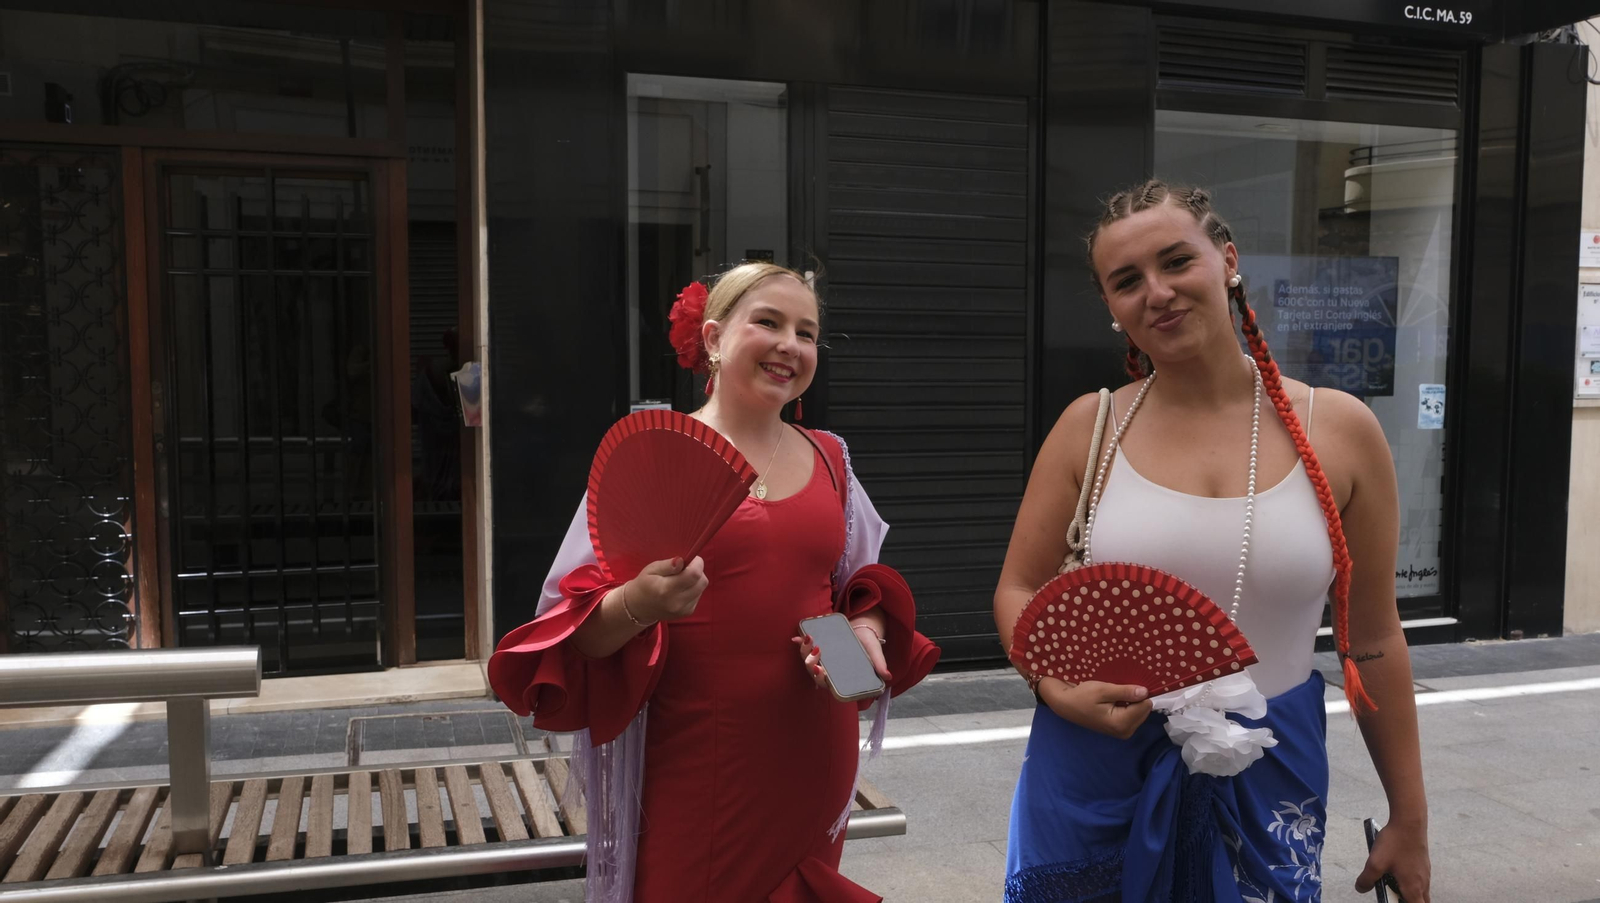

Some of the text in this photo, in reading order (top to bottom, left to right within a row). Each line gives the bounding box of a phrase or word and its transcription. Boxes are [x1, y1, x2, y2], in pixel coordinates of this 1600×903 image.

[1404, 5, 1473, 25] C.I.C. MA. 59
[1323, 285, 1331, 295] si
[1332, 286, 1364, 297] gastas
[1306, 299, 1325, 307] con
[1327, 298, 1338, 307] tu
[1277, 310, 1312, 321] Tarjeta
[1314, 310, 1323, 319] El
[1354, 310, 1382, 322] Inglés
[1277, 321, 1354, 333] en el extranjero
